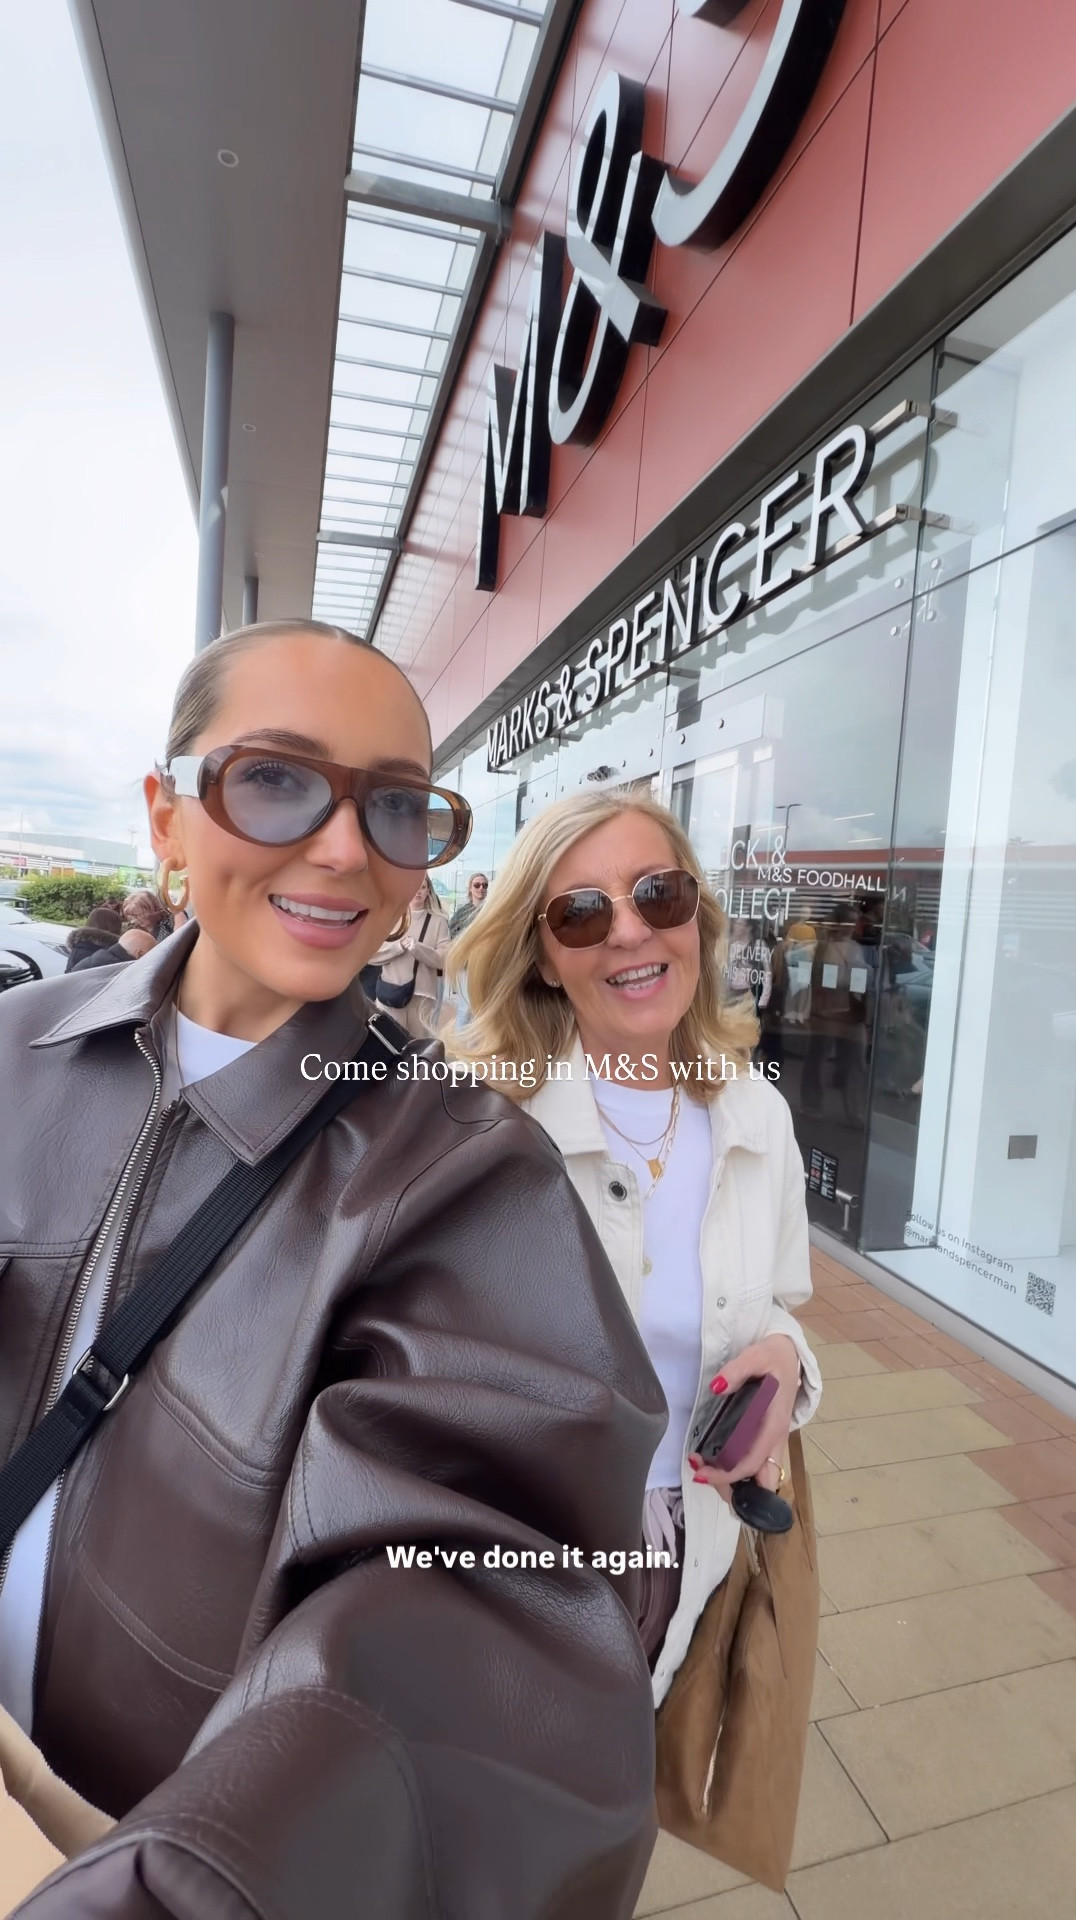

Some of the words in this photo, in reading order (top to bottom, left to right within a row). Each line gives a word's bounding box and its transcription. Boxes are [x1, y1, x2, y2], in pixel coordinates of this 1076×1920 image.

[486, 679, 556, 770] MARKS
[555, 664, 581, 729] &
[584, 424, 876, 708] SPENCER
[771, 834, 787, 868] &
[757, 866, 792, 884] M&S
[797, 868, 887, 892] FOODHALL
[714, 887, 797, 921] OLLECT
[721, 965, 738, 981] HIS
[905, 1209, 934, 1231] Follow
[948, 1232, 960, 1245] on
[961, 1237, 1015, 1274] Instagram
[904, 1225, 1018, 1295] @marandspencerman
